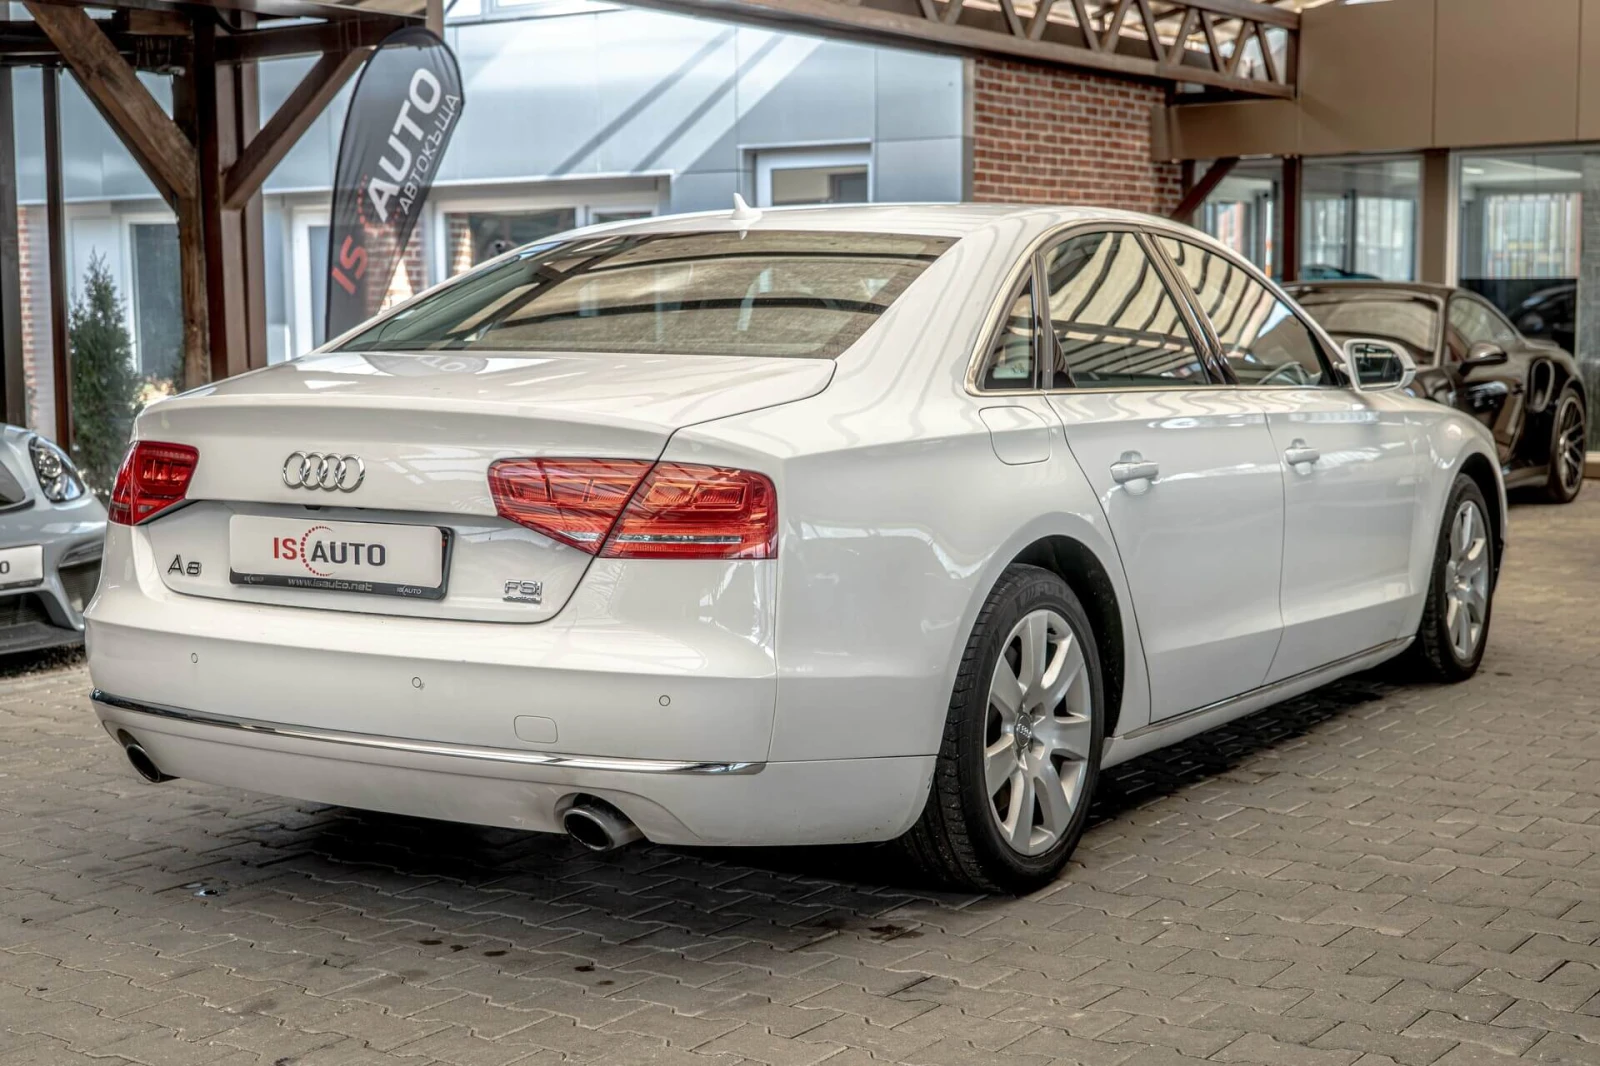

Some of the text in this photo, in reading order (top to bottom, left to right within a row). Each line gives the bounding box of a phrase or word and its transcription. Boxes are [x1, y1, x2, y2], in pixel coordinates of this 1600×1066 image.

[399, 94, 460, 215] АВТОКЪЩА
[332, 68, 441, 294] IS AUTO
[273, 537, 386, 566] IS AUTO
[168, 554, 202, 576] A8
[288, 576, 373, 592] www.isauto.net
[404, 587, 422, 595] AUTO
